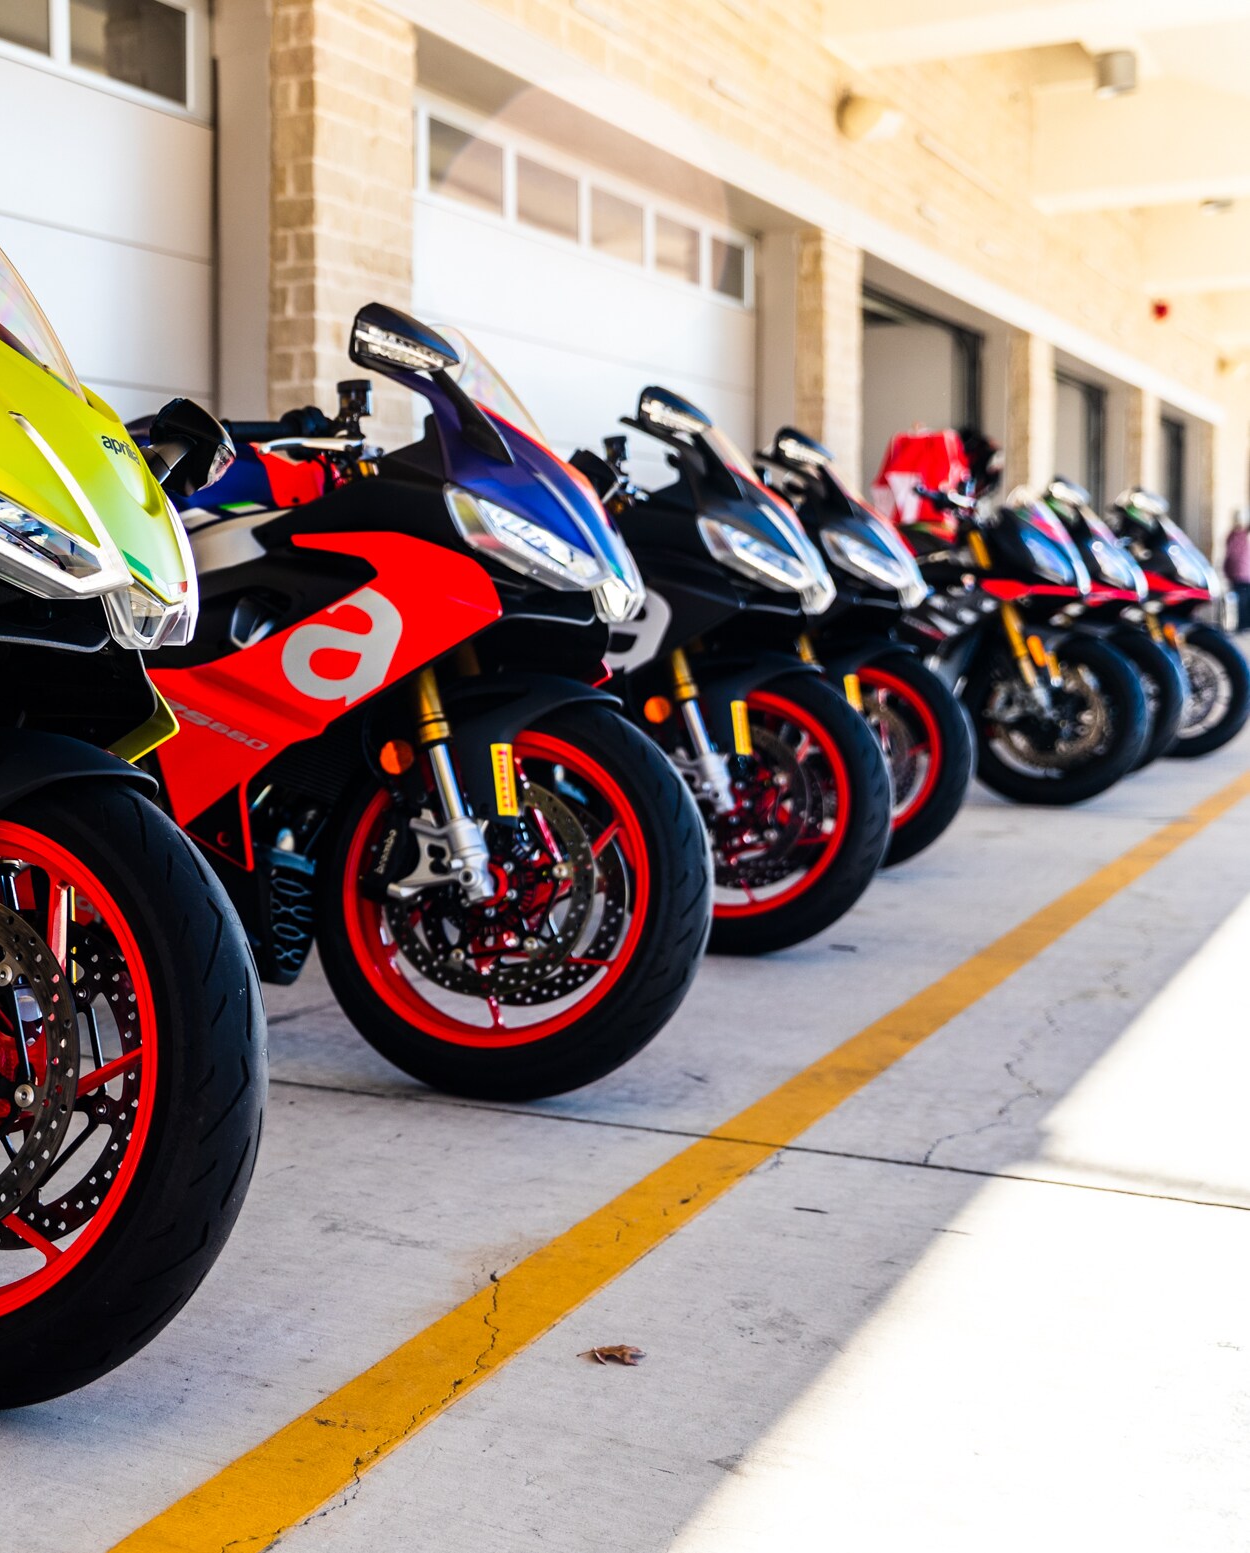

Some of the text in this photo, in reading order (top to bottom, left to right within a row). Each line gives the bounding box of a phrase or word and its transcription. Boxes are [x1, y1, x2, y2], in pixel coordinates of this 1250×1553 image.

[101, 435, 141, 466] aprilia
[281, 586, 403, 706] a
[497, 750, 513, 808] PIRELLI
